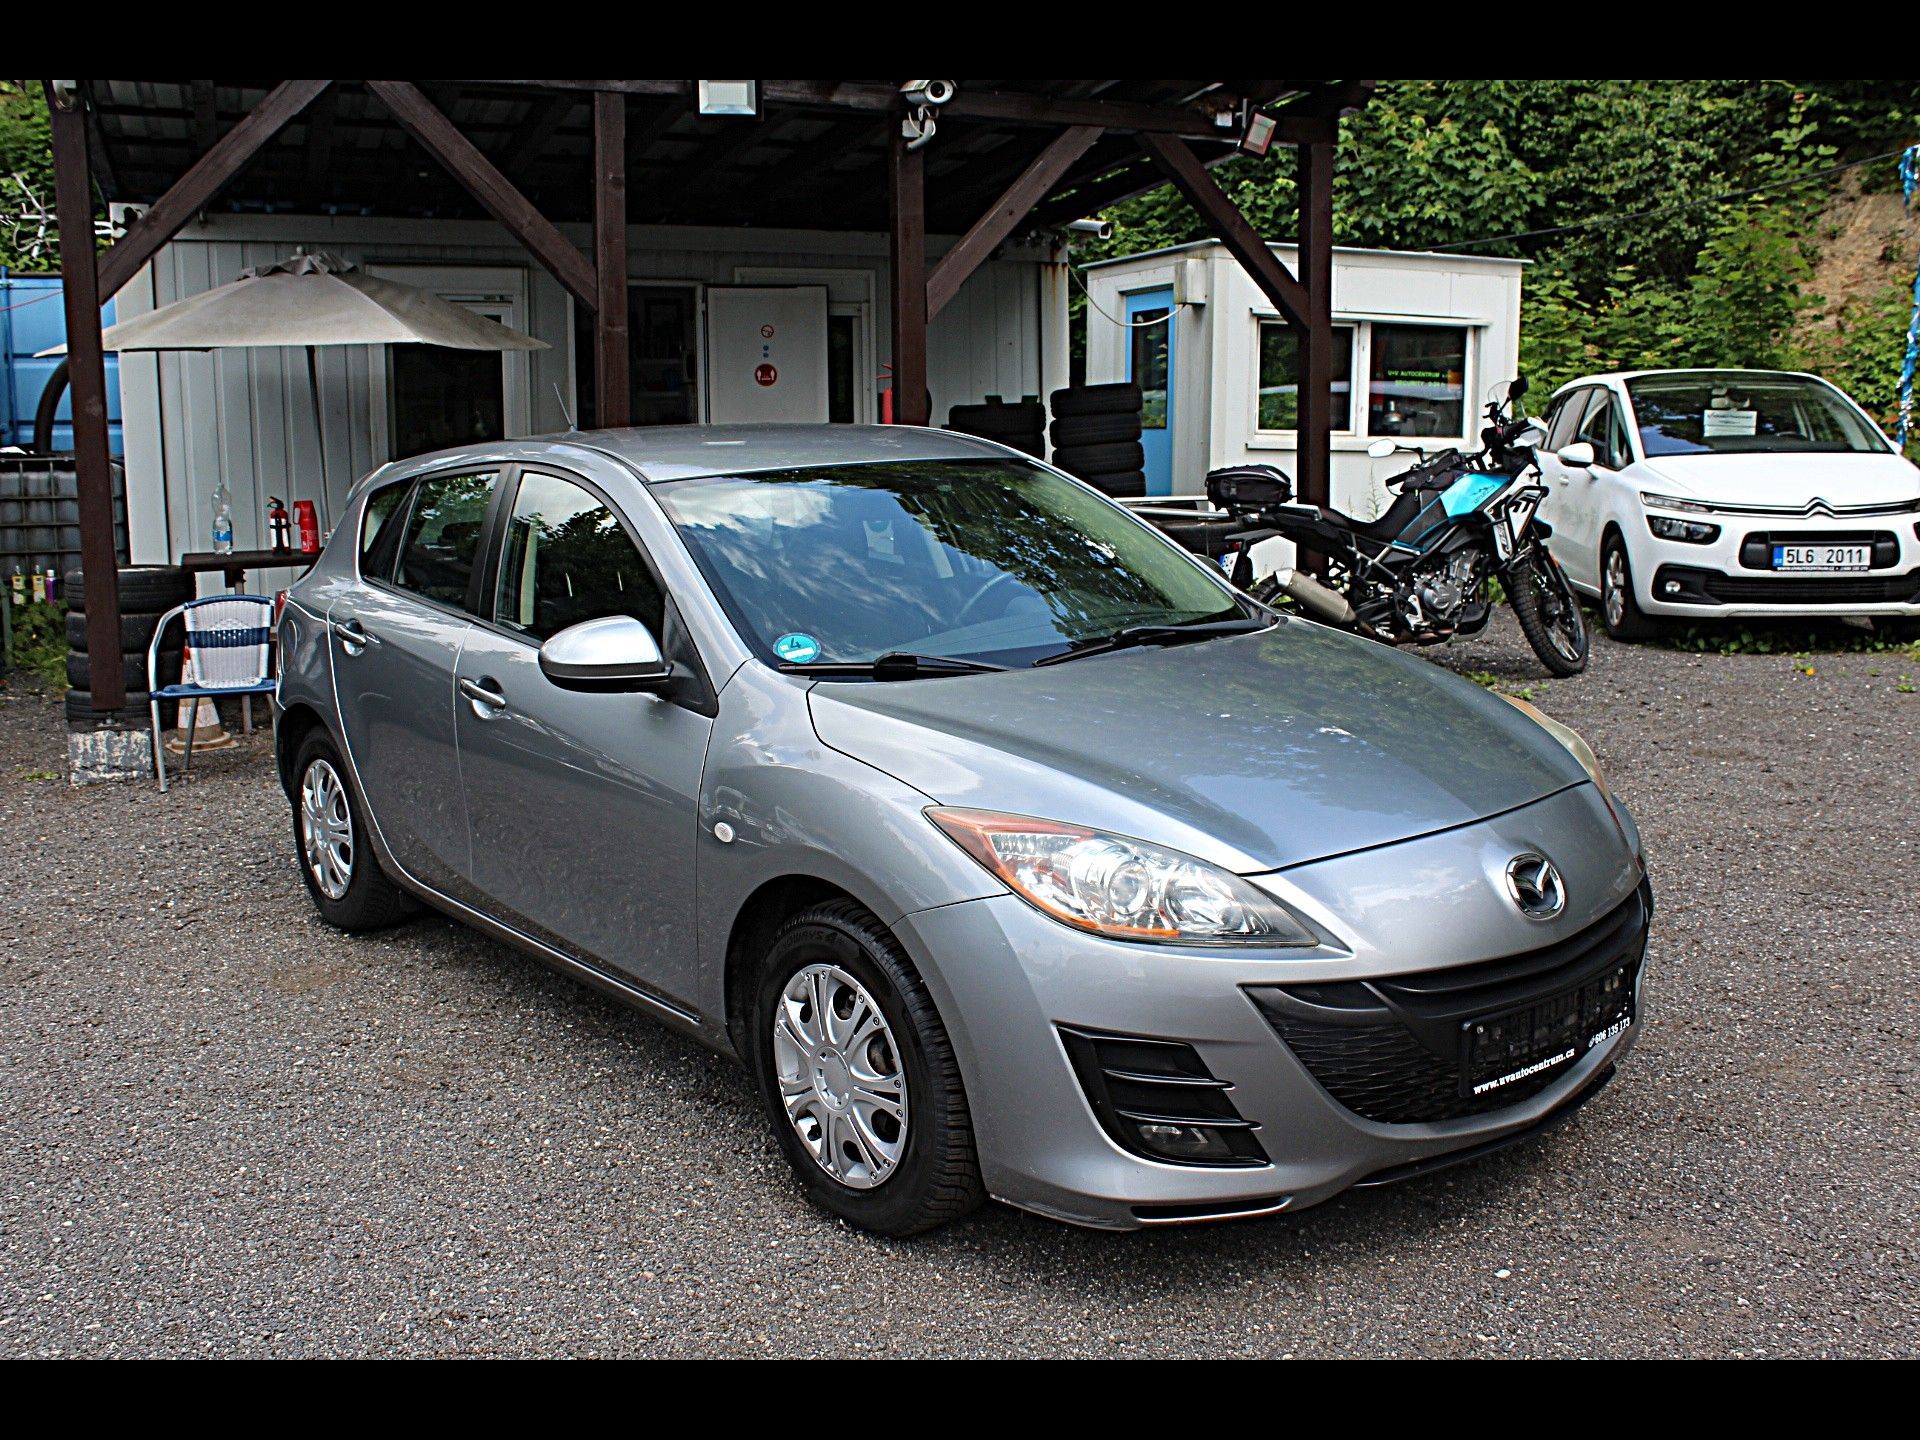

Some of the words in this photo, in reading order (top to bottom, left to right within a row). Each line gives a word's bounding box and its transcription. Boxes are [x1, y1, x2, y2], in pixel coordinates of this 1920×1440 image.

[1786, 548, 1814, 564] 5L6
[1826, 548, 1863, 564] 2011
[1607, 1023, 1619, 1038] 135
[1620, 1016, 1631, 1031] 173
